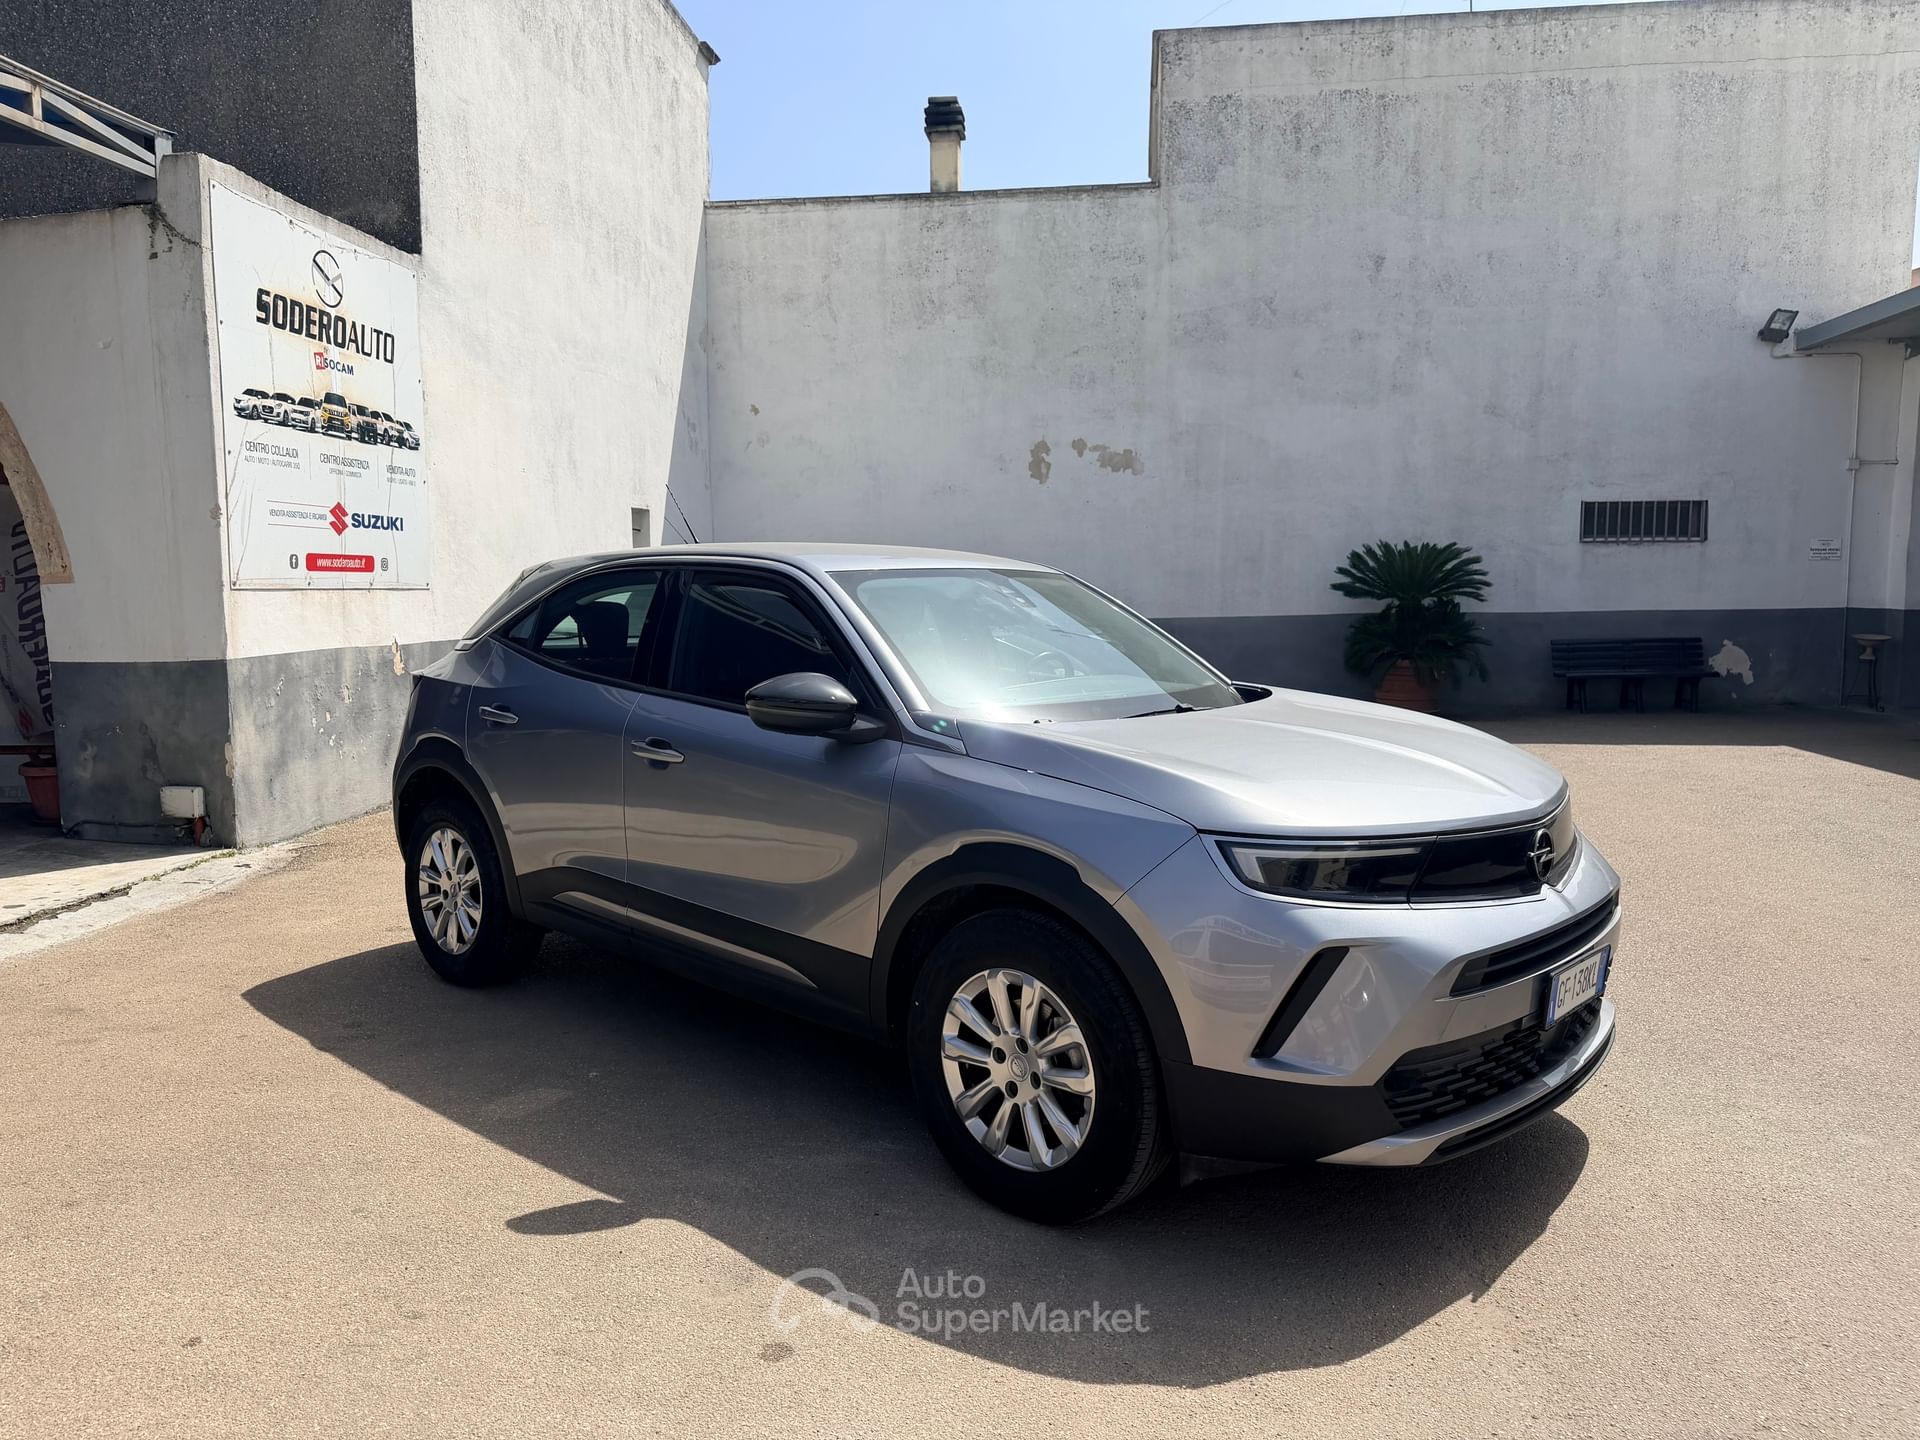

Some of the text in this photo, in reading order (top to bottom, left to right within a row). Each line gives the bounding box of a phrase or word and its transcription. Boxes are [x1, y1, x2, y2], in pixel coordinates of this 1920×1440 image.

[256, 287, 395, 364] SODEROAUTO
[314, 352, 354, 376] RISOCAM
[245, 440, 299, 459] CENTRO COLLAUDI
[320, 453, 370, 470] CENTRO ASSISTENZA
[351, 512, 404, 532] SUZUKI
